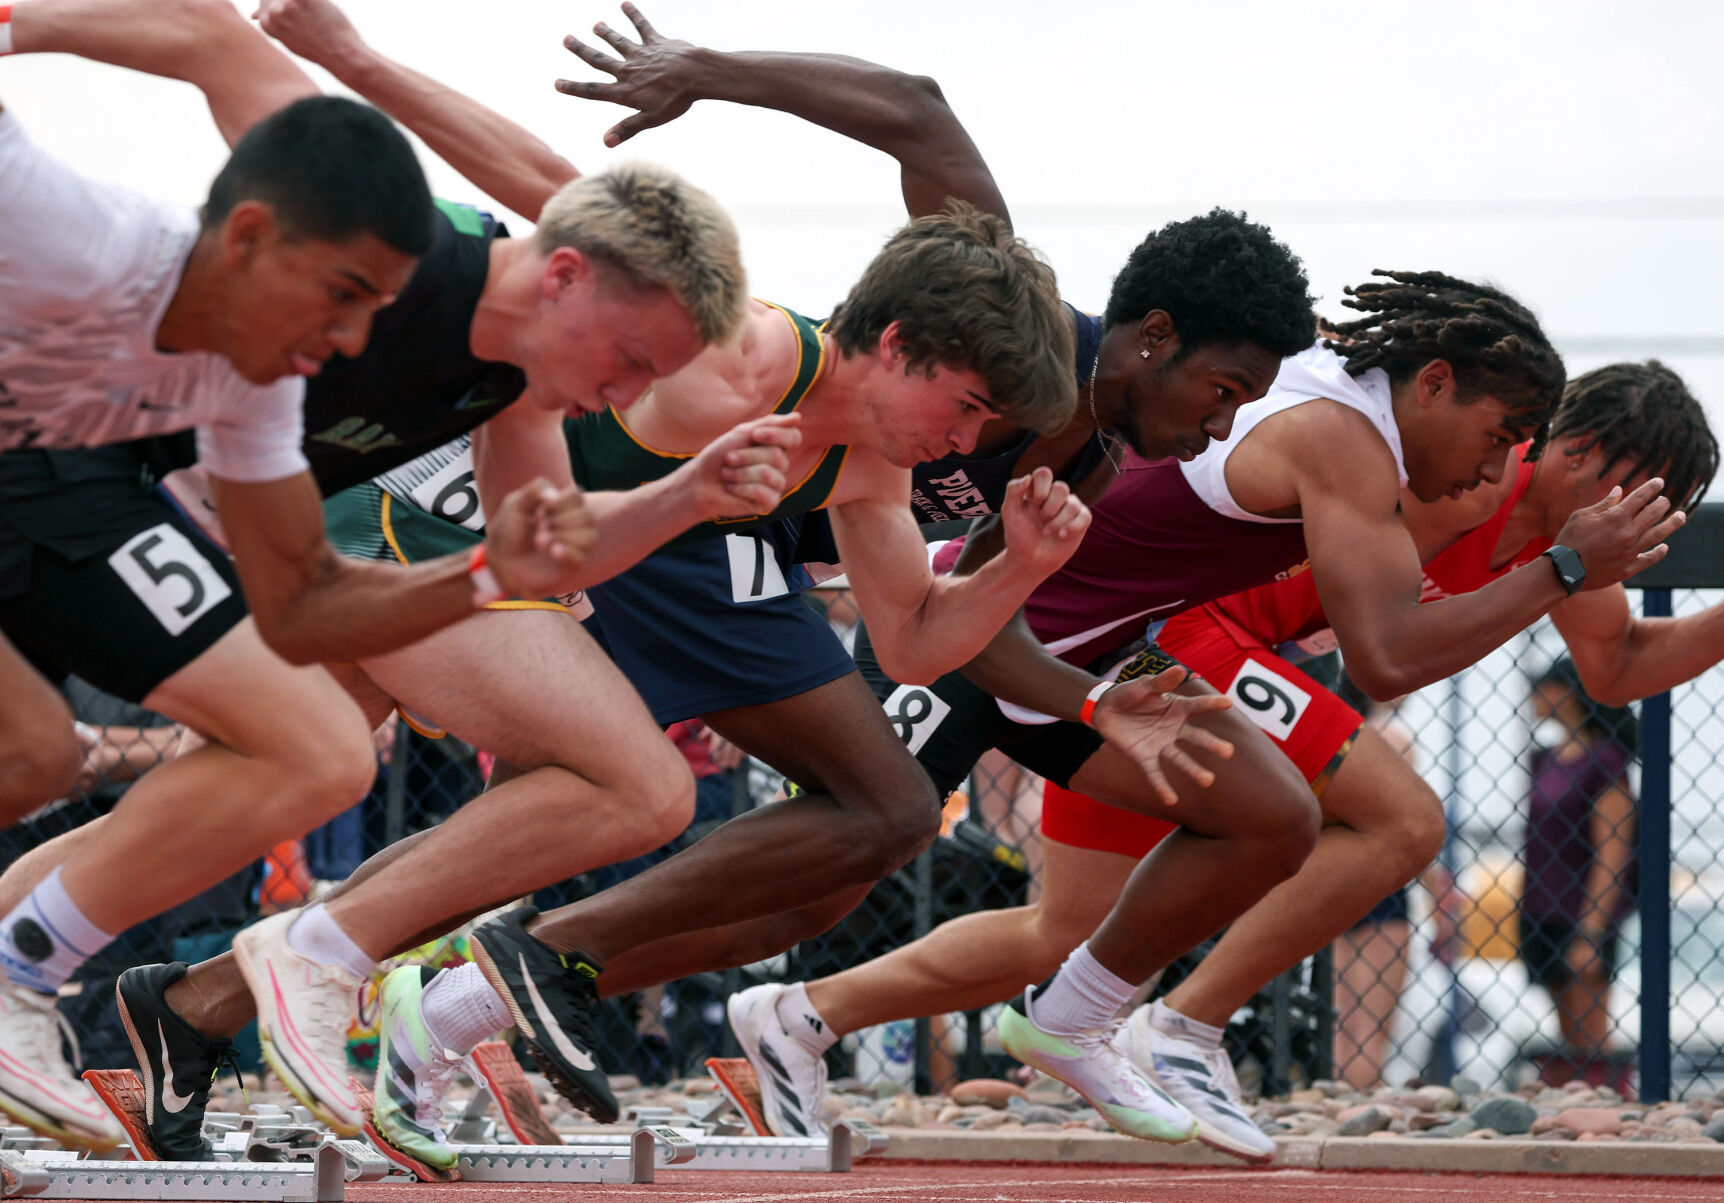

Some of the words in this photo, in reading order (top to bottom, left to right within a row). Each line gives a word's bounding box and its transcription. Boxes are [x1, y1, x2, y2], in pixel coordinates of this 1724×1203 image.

[431, 470, 479, 524] 6
[129, 534, 205, 618] 5
[888, 689, 932, 746] 8
[1236, 675, 1296, 726] 9
